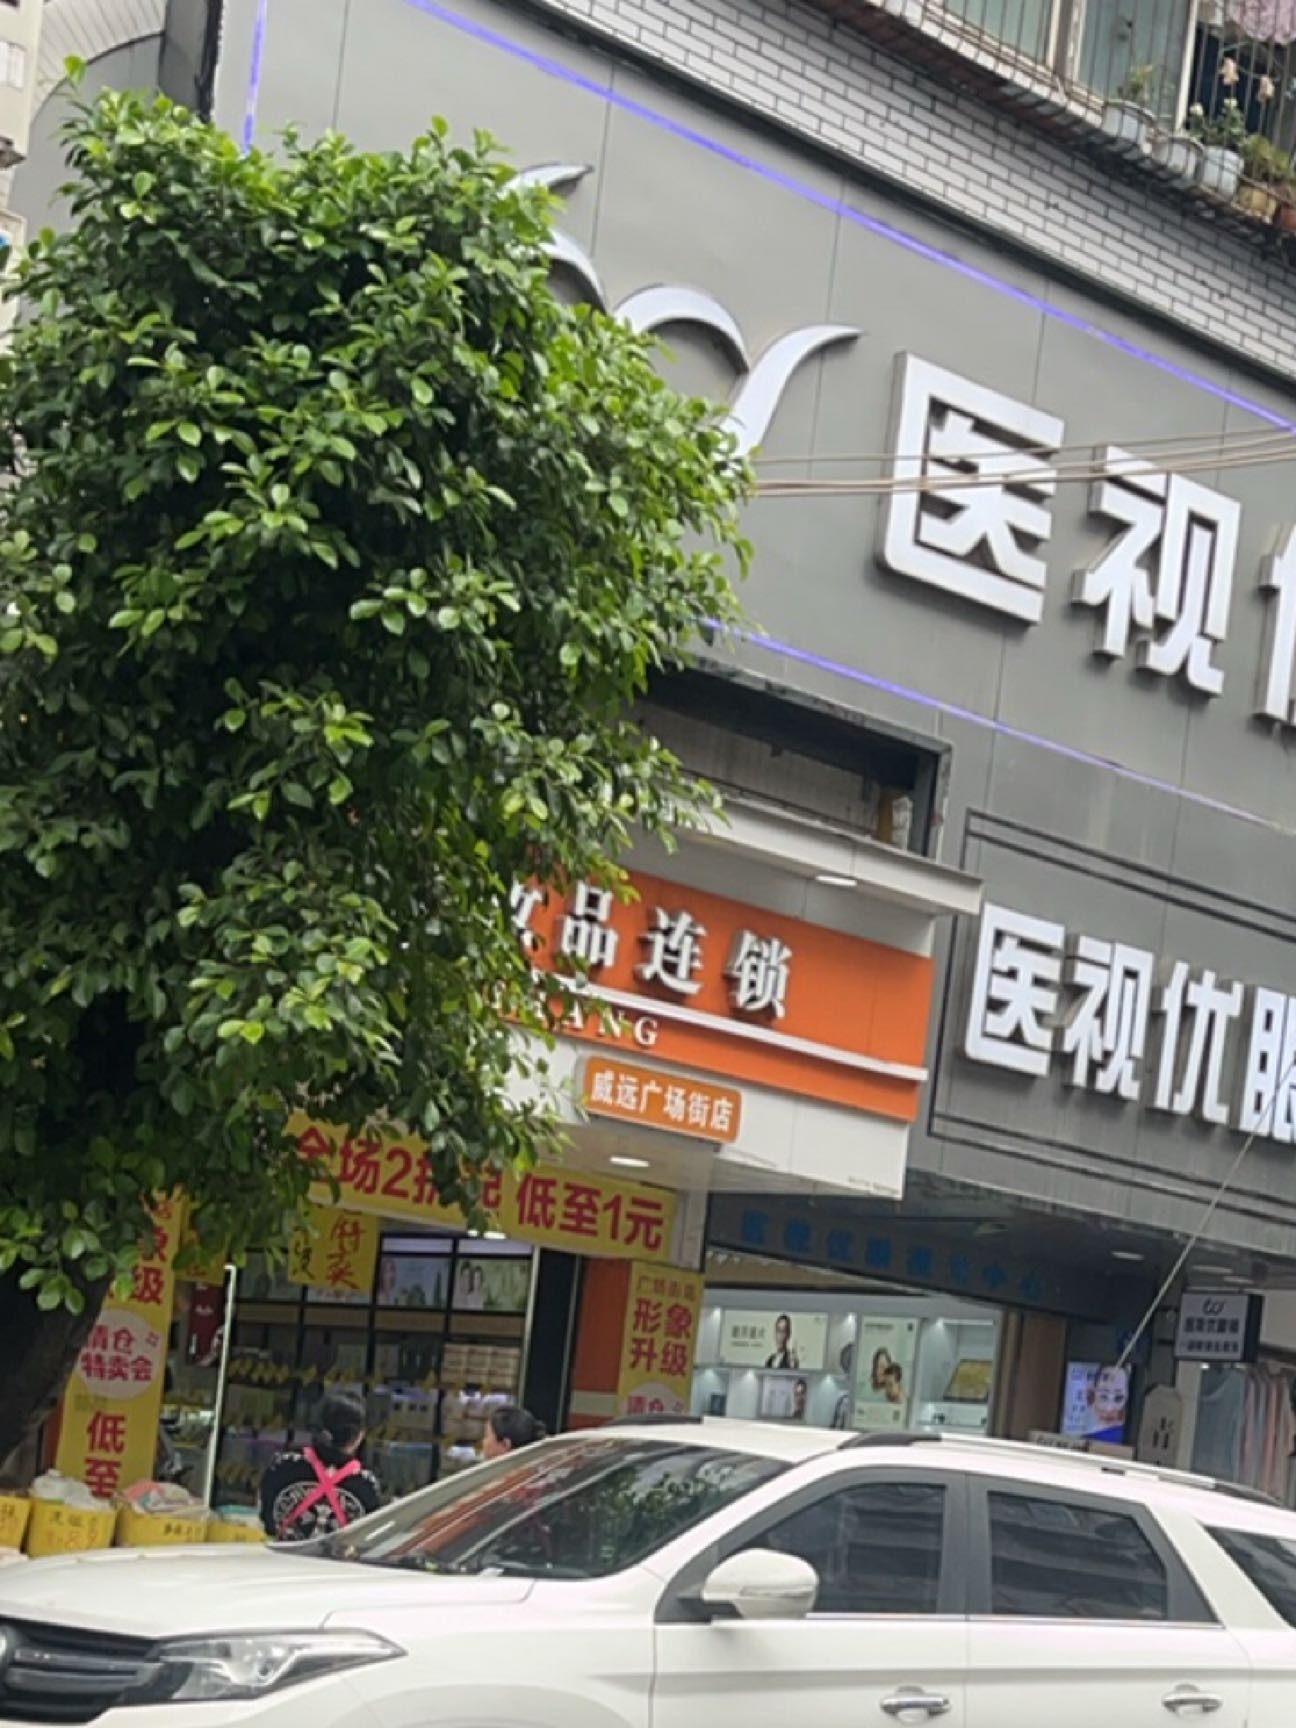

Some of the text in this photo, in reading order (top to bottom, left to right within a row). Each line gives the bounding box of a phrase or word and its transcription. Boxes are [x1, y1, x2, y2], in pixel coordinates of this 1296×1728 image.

[590, 1069, 734, 1133] 威远广场街店
[517, 1172, 665, 1252] 低至1元
[633, 1298, 693, 1339] 形象
[80, 1354, 152, 1381] 特卖会
[629, 1338, 687, 1377] 升级
[85, 1411, 126, 1499] 低至
